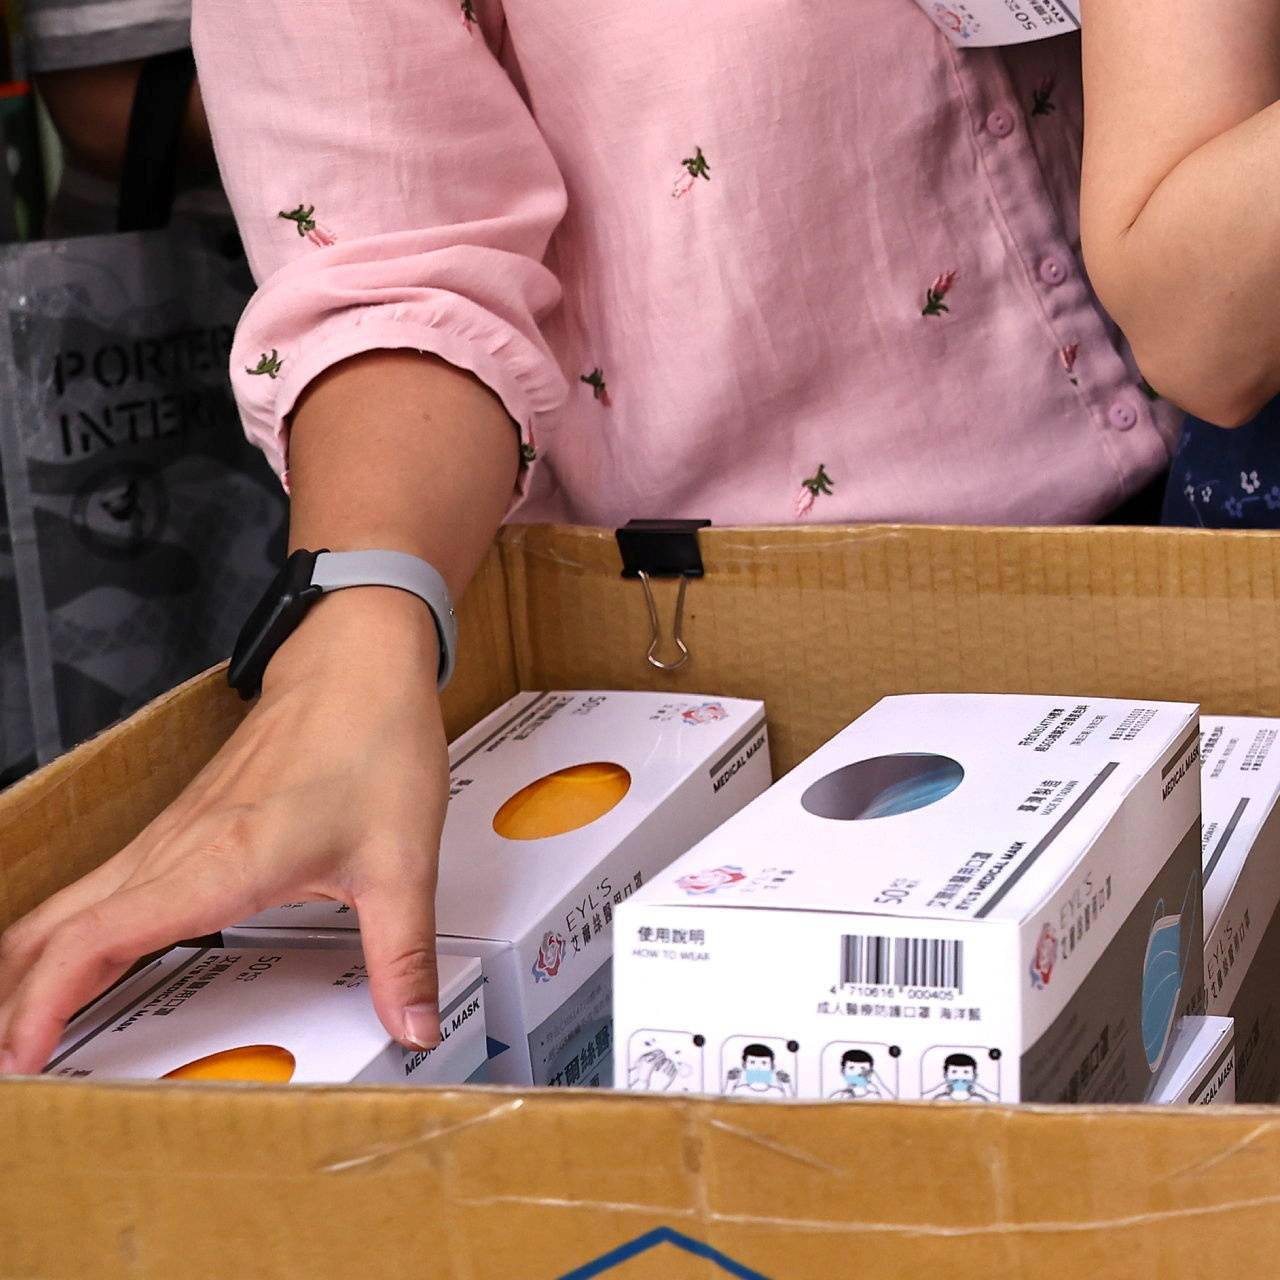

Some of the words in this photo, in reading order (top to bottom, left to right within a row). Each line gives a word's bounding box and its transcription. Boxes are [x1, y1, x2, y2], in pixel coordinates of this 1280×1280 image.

[712, 754, 748, 795] MEDICAL
[747, 734, 766, 760] MASK
[565, 876, 613, 933] EYL'S
[570, 870, 644, 954] 艾爾絲醫用口罩
[638, 926, 706, 947] 使用說明
[249, 955, 283, 972] 50
[451, 997, 481, 1032] MASK
[1216, 1058, 1235, 1088] MASK
